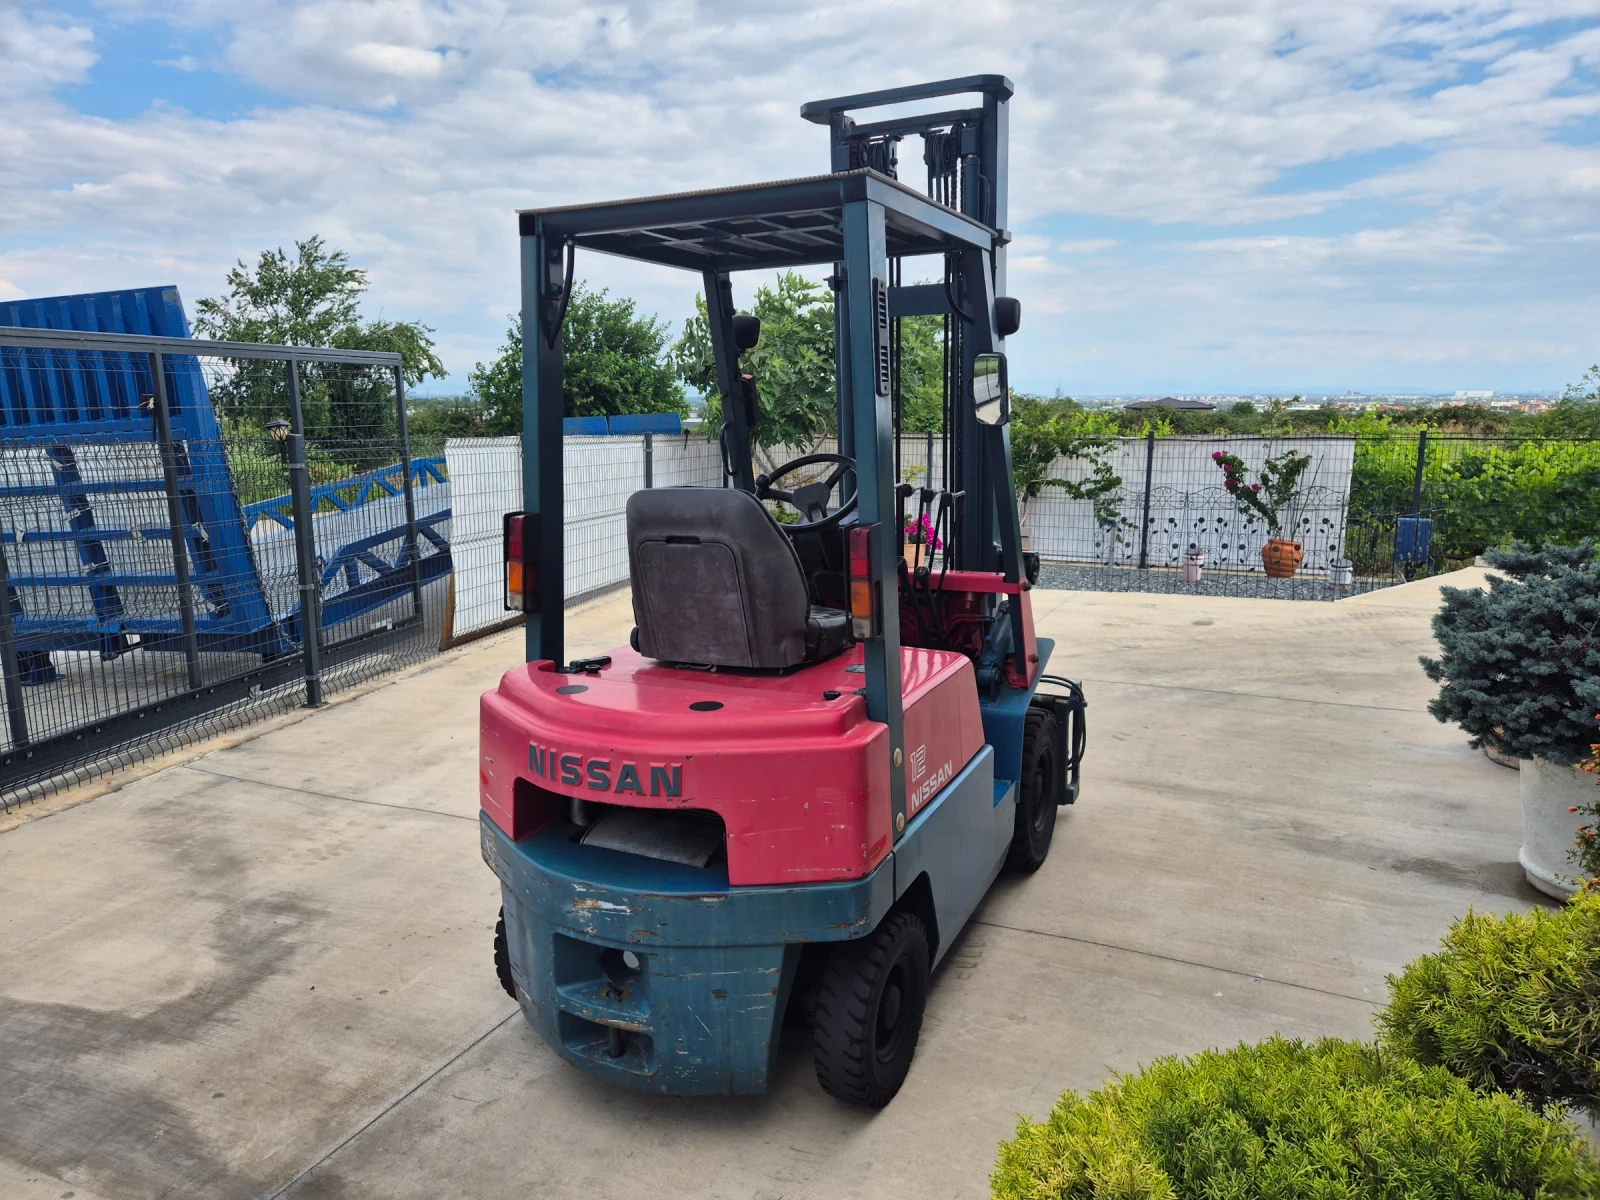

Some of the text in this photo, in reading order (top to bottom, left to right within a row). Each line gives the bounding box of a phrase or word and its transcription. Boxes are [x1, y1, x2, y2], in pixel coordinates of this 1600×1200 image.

[528, 739, 682, 797] NISSAN
[910, 744, 926, 782] 12
[911, 760, 953, 811] NISSAN
